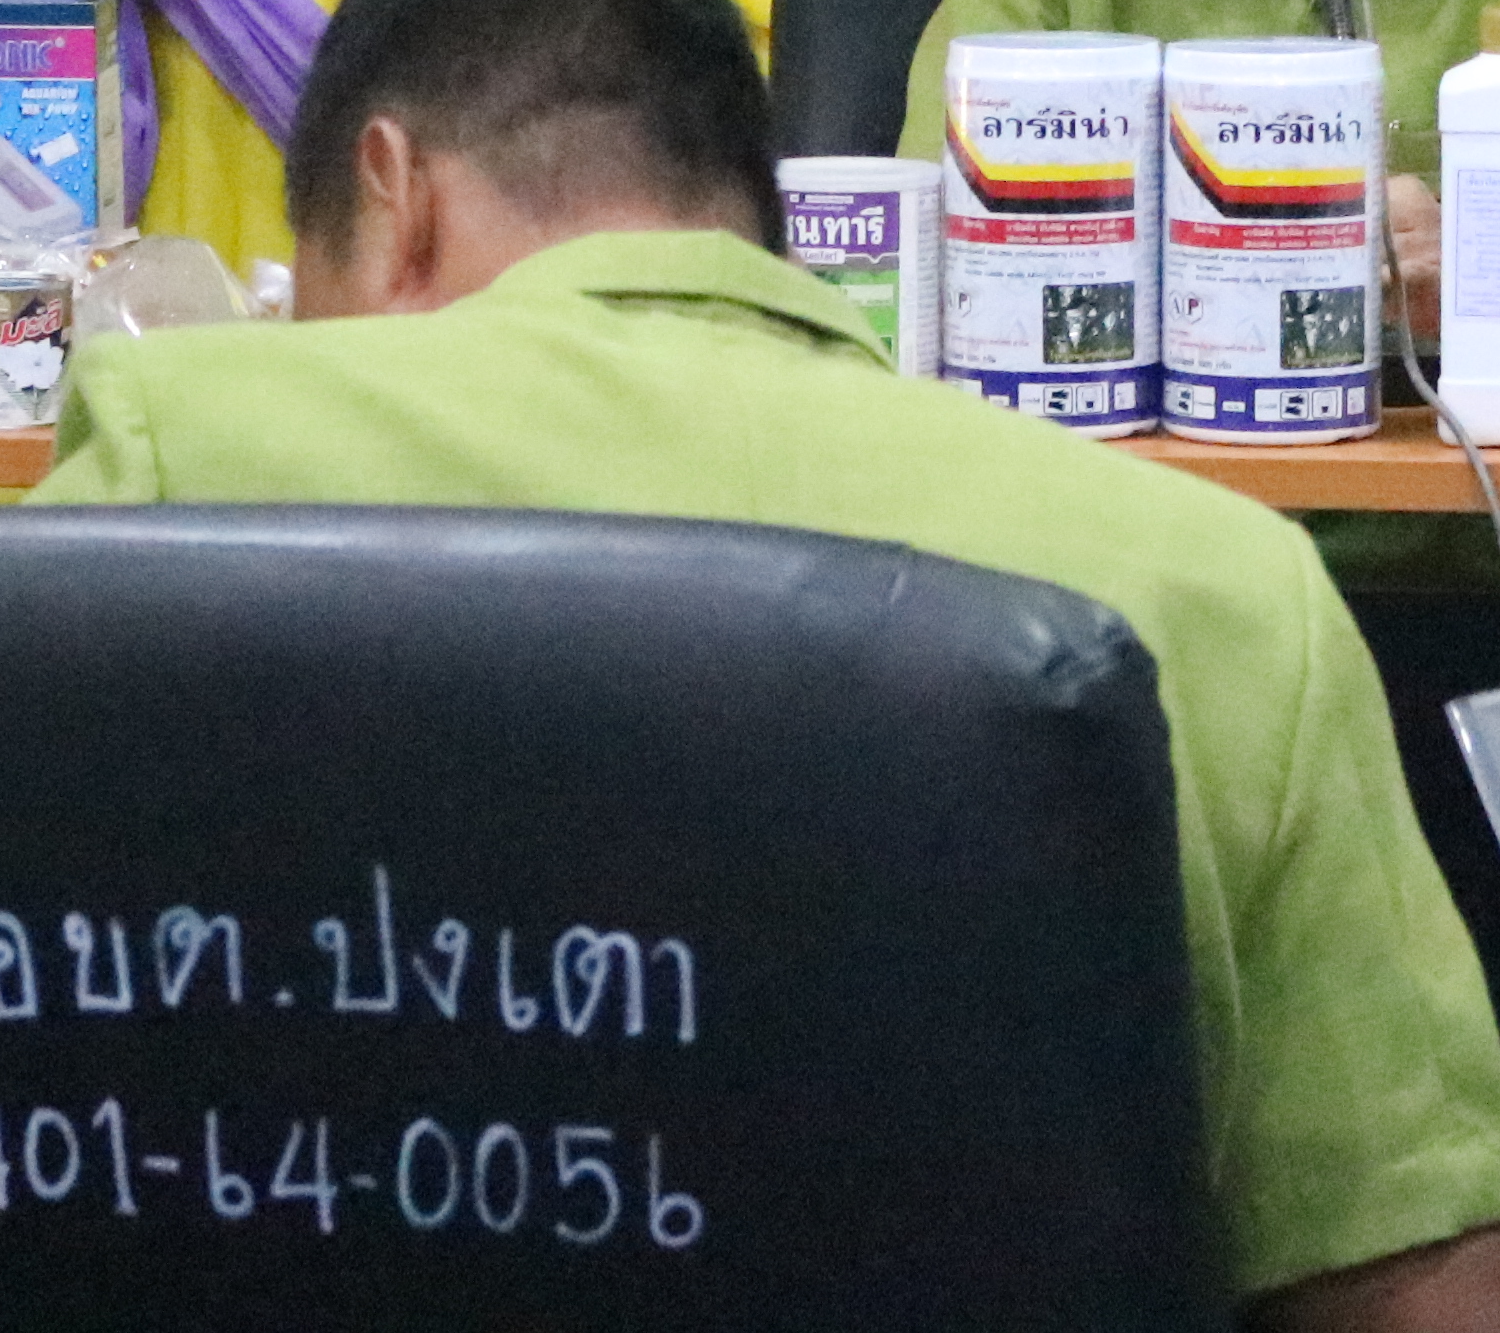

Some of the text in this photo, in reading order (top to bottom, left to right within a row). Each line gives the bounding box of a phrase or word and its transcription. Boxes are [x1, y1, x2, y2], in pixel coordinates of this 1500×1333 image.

[982, 107, 1129, 140] ลาร์มิน่า
[1217, 111, 1362, 145] ลาร์มิน่า
